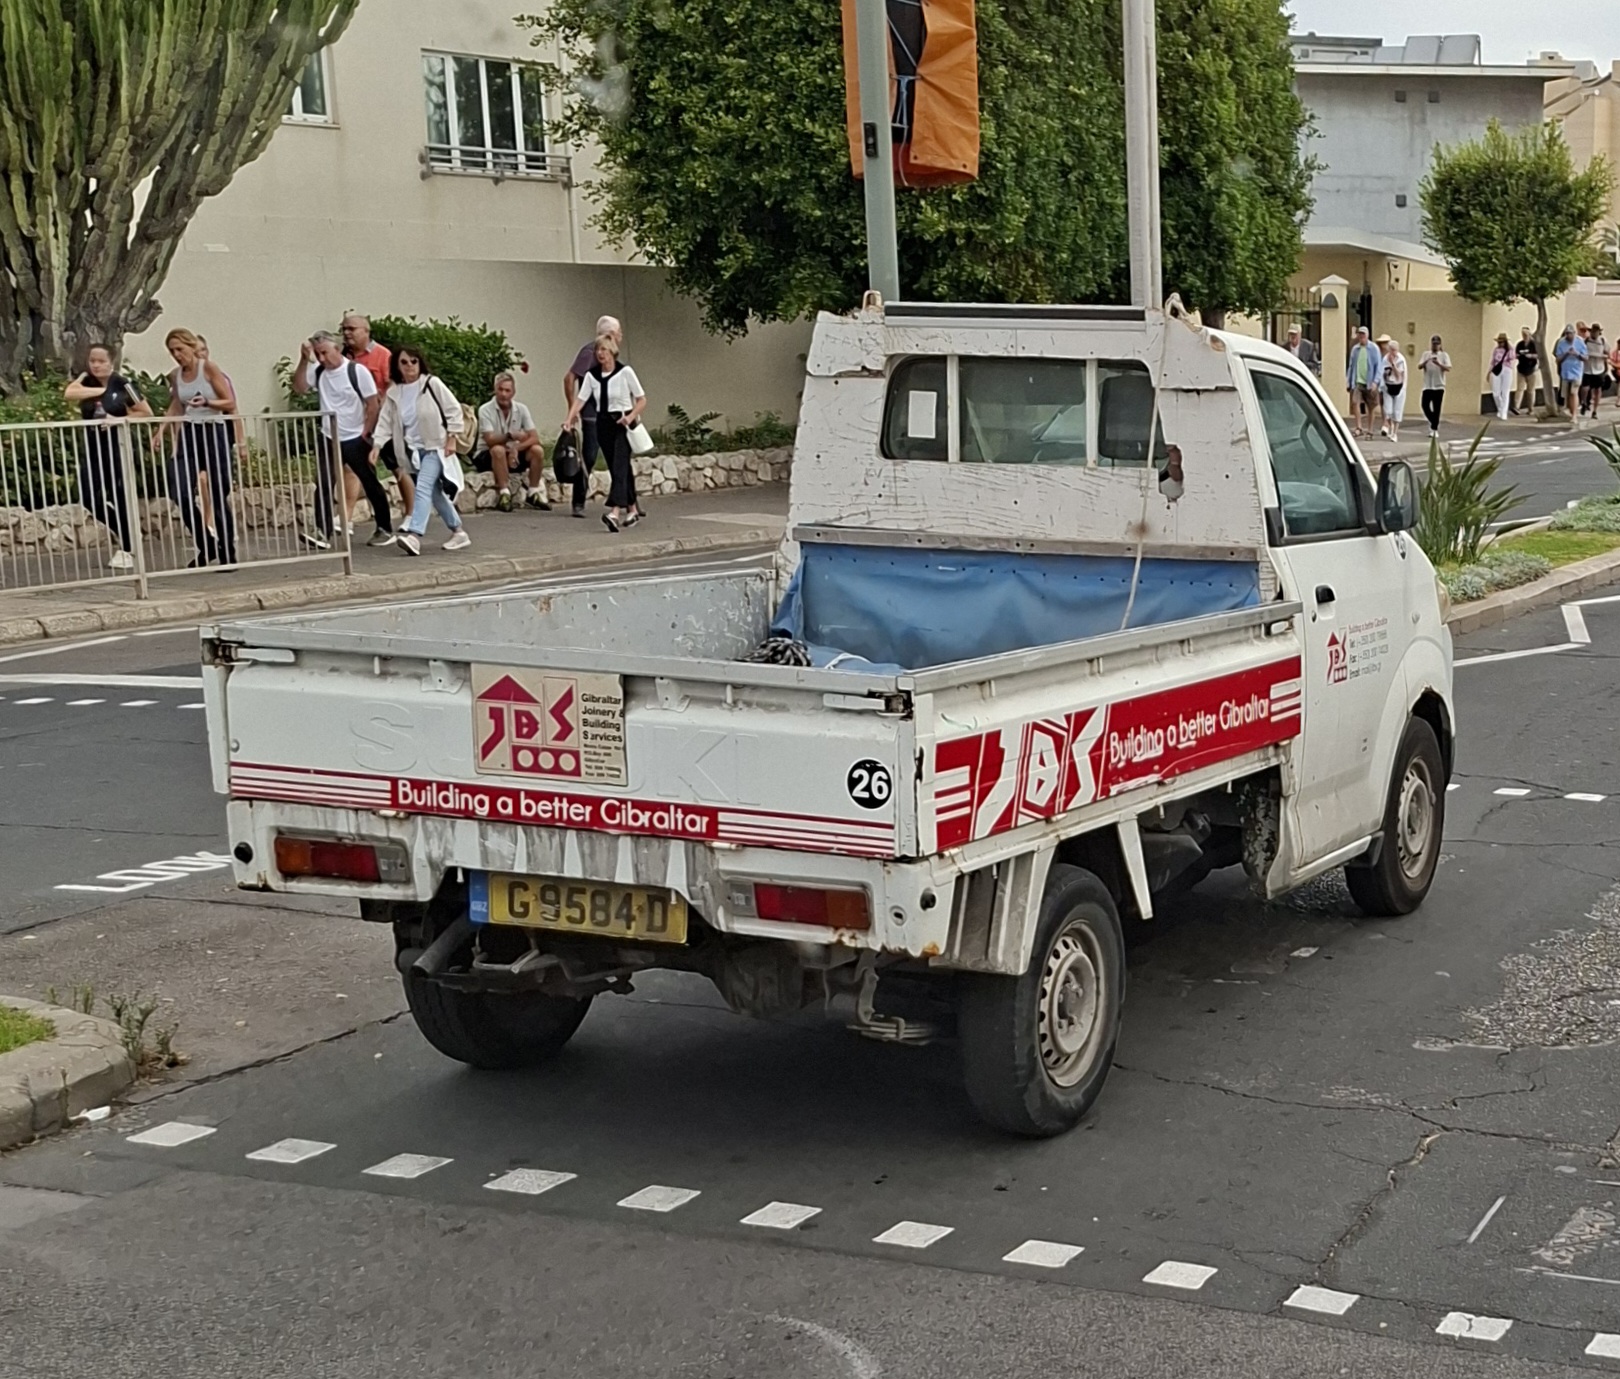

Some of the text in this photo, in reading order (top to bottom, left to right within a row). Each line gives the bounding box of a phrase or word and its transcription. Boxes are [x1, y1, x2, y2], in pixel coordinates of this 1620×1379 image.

[581, 692, 622, 705] Gibraltar
[581, 705, 617, 719] Joinery
[479, 684, 575, 762] JBS
[582, 718, 622, 732] Building
[1109, 693, 1269, 764] Building a better Gibraltar
[852, 768, 889, 800] 26
[397, 778, 710, 833] Building a better Gibraltar
